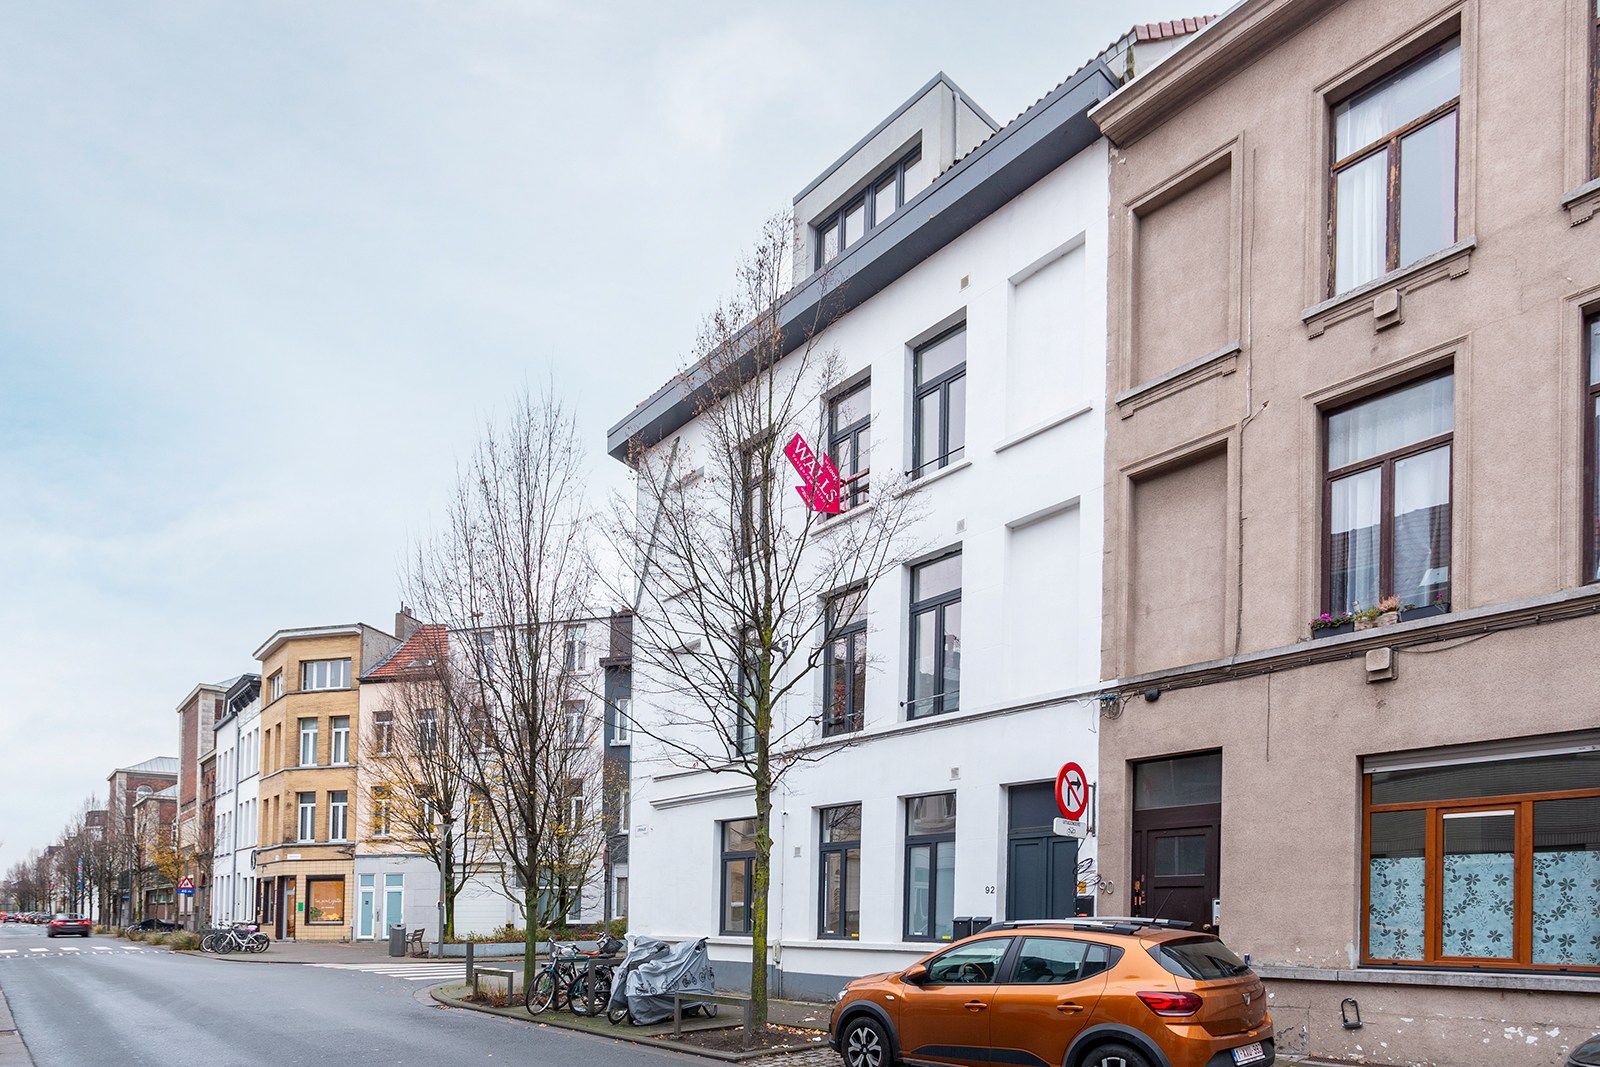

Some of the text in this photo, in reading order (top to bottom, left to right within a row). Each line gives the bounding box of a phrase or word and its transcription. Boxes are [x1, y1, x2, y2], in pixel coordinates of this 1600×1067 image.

[795, 438, 838, 502] WALLS
[985, 886, 995, 894] 92
[1099, 880, 1114, 895] 90
